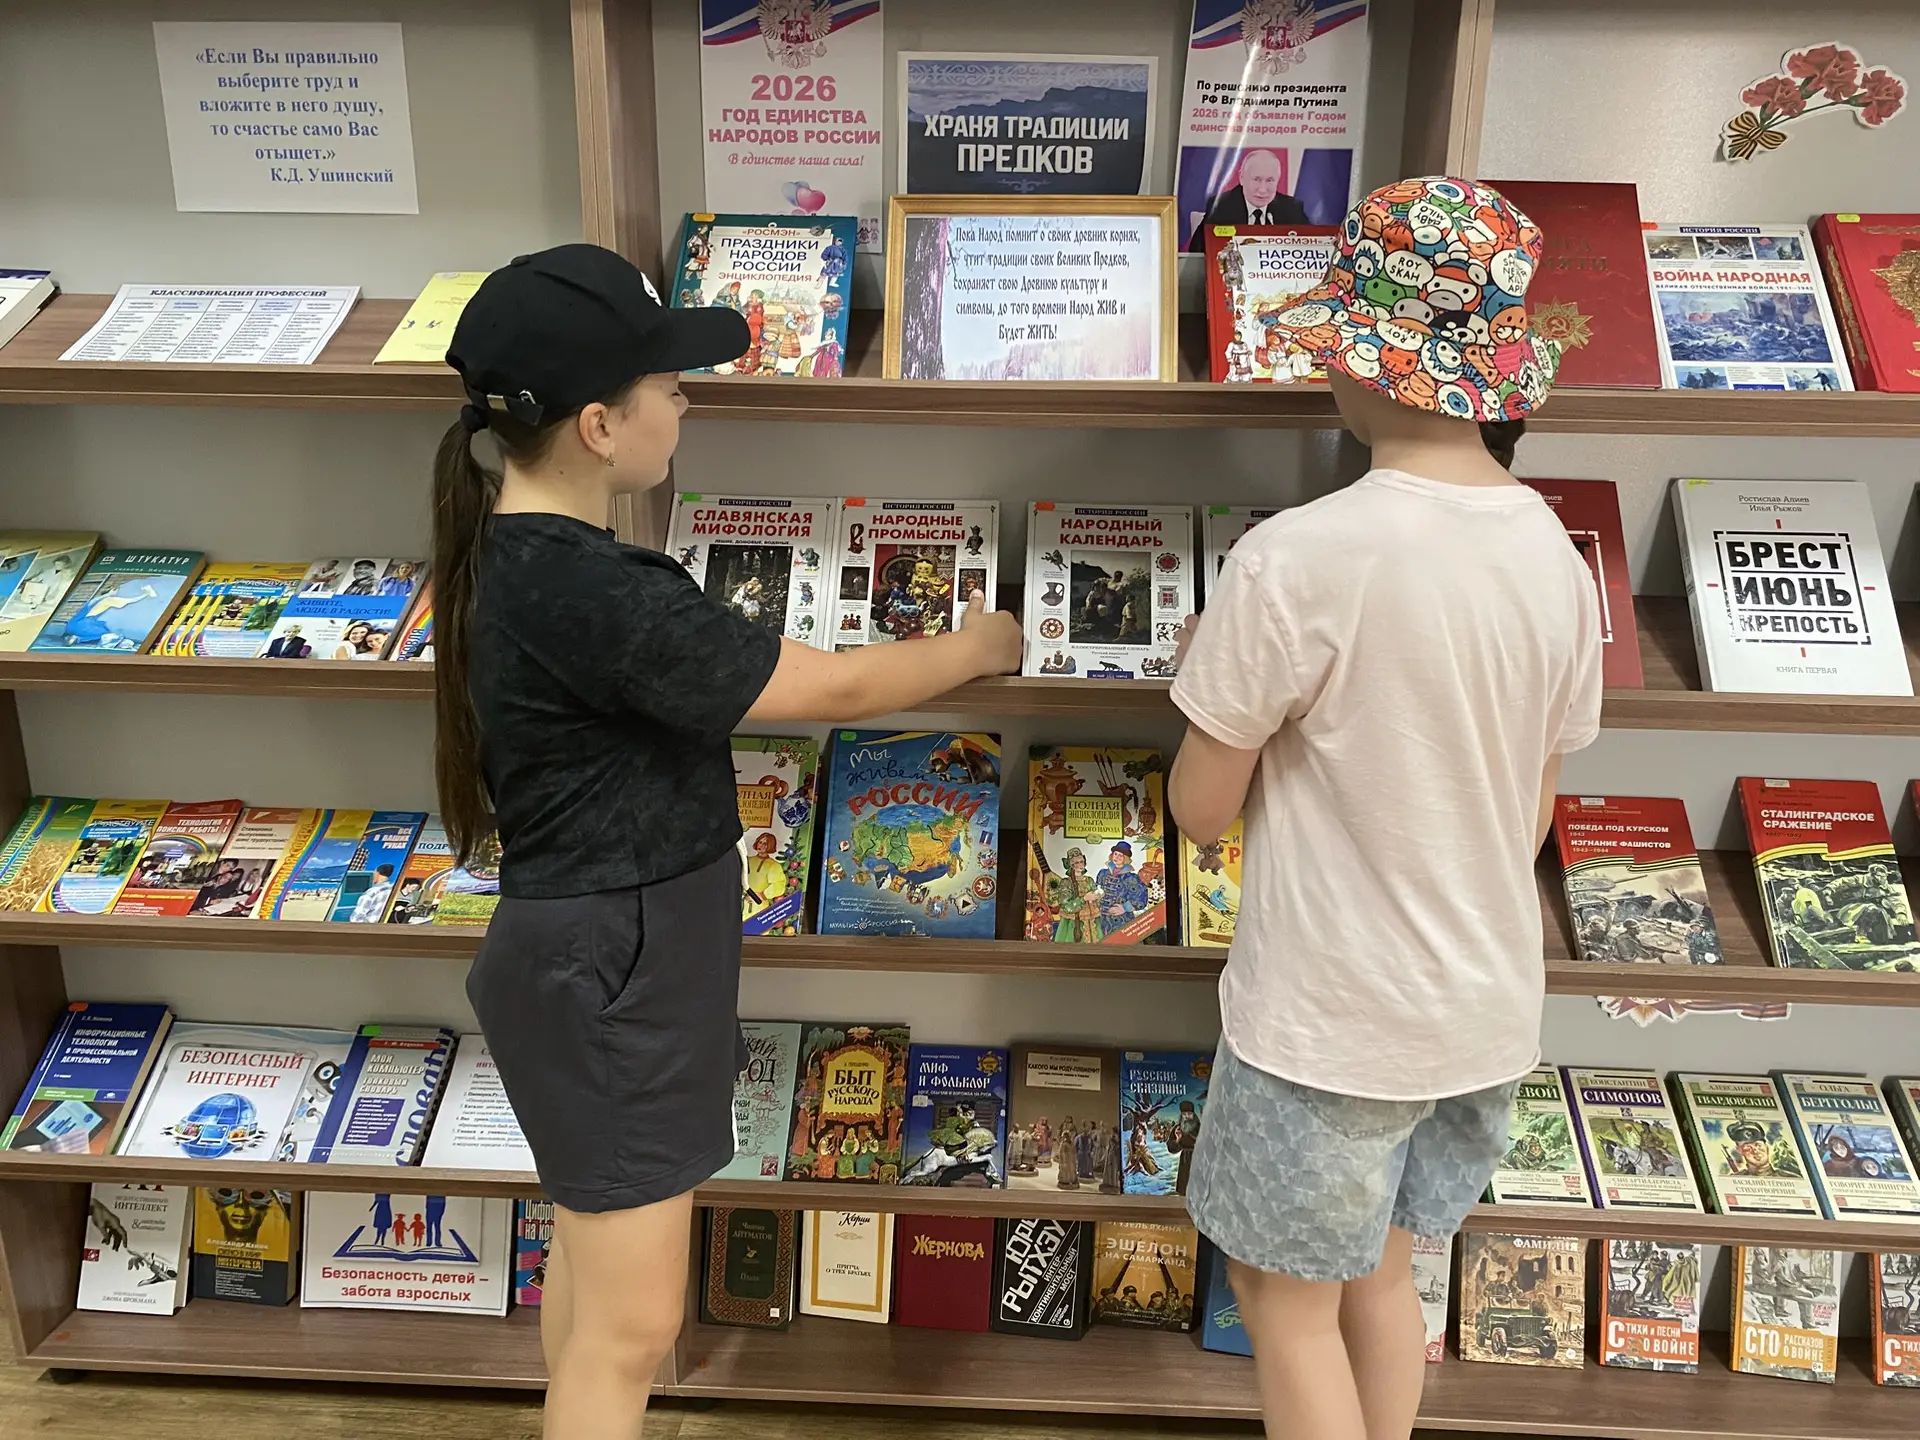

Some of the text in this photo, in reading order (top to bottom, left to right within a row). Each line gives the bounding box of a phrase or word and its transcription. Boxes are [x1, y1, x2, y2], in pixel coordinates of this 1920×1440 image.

[196, 48, 378, 68] «Если Вы правильно
[218, 74, 359, 92] выберите труд и
[751, 75, 837, 101] 2026
[1197, 81, 1347, 95] По президента
[200, 99, 384, 117] вложите в него душу,
[1202, 95, 1338, 108] РФ Путина
[722, 109, 867, 125] ГОД ЕДИНСТВА
[1193, 108, 1346, 121] 2026 Годом
[211, 121, 378, 137] то счастье само Вас
[924, 114, 1129, 141] ХРАНЯ ТРАДИЦИИ
[1247, 125, 1346, 135] народов России
[709, 129, 881, 145] НАРОДОВ РОССИИ
[255, 147, 336, 163] отыщет.»
[728, 152, 864, 166] В единстве наша сила!
[957, 144, 1093, 174] ПРЕДКОВ
[271, 168, 394, 184] К.Д. Ушинский
[955, 227, 1141, 246] Пока Народ помнит своих древних корнях,
[721, 239, 819, 250] ПРАЗДНИКИ
[729, 251, 807, 263] НАРОДОВ
[963, 251, 1130, 270] чтит традиции своих Великих Предков,
[1259, 250, 1329, 259] НАРОДЫ
[732, 261, 801, 272] РОССИИ
[1260, 261, 1330, 270] РОССИИ
[1398, 256, 1421, 271] ROY
[718, 272, 812, 283] ЭНЦИКЛОПЕДИЯ
[1653, 270, 1812, 284] ВОЙНА НАРОДНАЯ
[150, 288, 328, 299] КЛАССИФИКАЦИЯ ПРОФЕССИЙ
[998, 279, 1019, 290] свою
[1021, 277, 1058, 294] Древнюю
[1060, 278, 1100, 296] культуру
[956, 300, 1118, 319] символы, до того времени Народ ЖИВ
[999, 325, 1057, 344] Будет ЖИТЬ!
[1738, 494, 1810, 504] Ростислав Алиев
[1773, 505, 1803, 513] Рыжов
[693, 510, 813, 524] СЛАВЯНСКАЯ
[872, 515, 963, 527] НАРОДНЫЕ
[692, 523, 811, 537] МИФОЛОГИЯ
[1060, 518, 1162, 532] НАРОДНЫЙ
[868, 529, 965, 541] ПРОМЫСЛЫ
[1059, 534, 1164, 548] КАЛЕНДАРЬ
[125, 556, 192, 565] ШТУКАТУР
[1726, 541, 1842, 570] БРЕСТ
[1732, 576, 1852, 607] ИЮНЬ
[1739, 615, 1859, 634] КРЕПОСТЬ
[1776, 666, 1838, 675] КНИГА ПЕРВАЯ
[850, 748, 891, 769] Мы
[847, 783, 985, 821] РОССИИ
[1069, 800, 1120, 810] ПОЛНАЯ
[1069, 810, 1120, 821] ЭНЦИКЛОПЕДИЯ
[1761, 810, 1875, 822] СТАЛИНГРАДСКОЕ
[1626, 825, 1669, 833] КУРСКОМ
[1764, 820, 1833, 830] СРАЖЕНИЕ
[1620, 841, 1671, 849] ФАШИСТОВ
[75, 1029, 147, 1039] ИНФОРМАЦИОННЫЕ
[71, 1038, 118, 1047] ТЕХНОЛОГИИ
[72, 1048, 139, 1057] ПРОФЕССИОНАЛЬНОЙ
[61, 1057, 112, 1065] ДЕЯТЕЛЬНОСТИ
[180, 1050, 304, 1070] БЕЗОПАСНЫЙ
[920, 1062, 948, 1074] МИФ
[187, 1071, 281, 1089] ИНТЕРНЕТ
[834, 1070, 876, 1086] БЫТ
[918, 1076, 990, 1089] И ФОЛЬКЛОР
[1129, 1069, 1177, 1082] РУССКИЕ
[1590, 1079, 1647, 1087] КОНСТАНТИН
[1820, 1085, 1850, 1093] ОЛЬГА
[828, 1085, 880, 1099] РУССКОГО
[1584, 1091, 1662, 1105] СИМОНОВ
[834, 1097, 873, 1106] НАРОДА
[1695, 1095, 1776, 1108] ТВАРДОВСКИЙ
[1800, 1097, 1880, 1112] БЕРГГОЛЬЦ
[1868, 1183, 1917, 1192] ЛЕНИНГРАД
[114, 1202, 169, 1213] ИНТЕЛЛЕКТ
[525, 1222, 537, 1240] на
[1150, 1223, 1182, 1233] ЯХИНА
[912, 1234, 985, 1260] ЖЕРНОВА
[1106, 1238, 1188, 1257] ЭШЕЛОН
[1513, 1238, 1579, 1252] ФАМИЛИЯ
[1002, 1219, 1067, 1313] РЫТХЭУ
[1105, 1251, 1186, 1268] НА САМАРКАНД
[1044, 1253, 1062, 1283] ИНТЕР-
[322, 1267, 476, 1285] Безопасность детей
[1060, 1269, 1076, 1293] МОСТ
[1031, 1247, 1078, 1323] КОНТИНЕНТАЛЬНЫЙ
[341, 1286, 471, 1302] забота взрослых
[1657, 1325, 1681, 1338] ПЕСНИ
[1643, 1338, 1695, 1356] О ВОЙНЕ
[1745, 1326, 1780, 1357] СТО
[1784, 1333, 1824, 1349] РАССКАЗОВ
[1791, 1347, 1824, 1361] ВОЙНЕ
